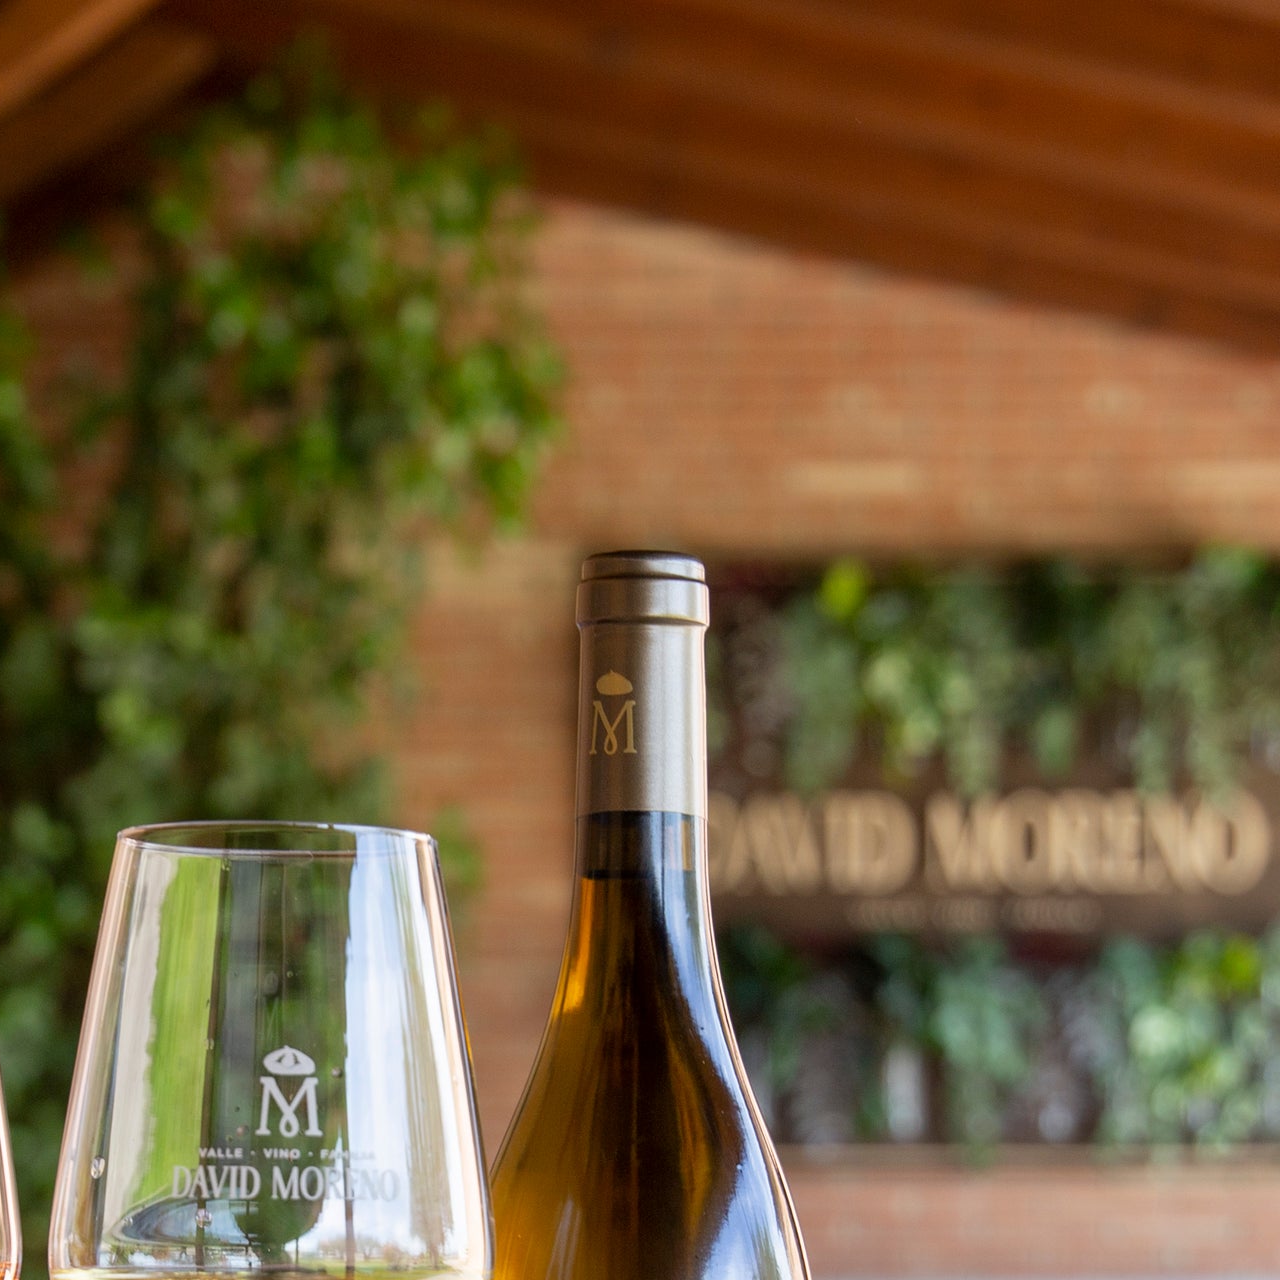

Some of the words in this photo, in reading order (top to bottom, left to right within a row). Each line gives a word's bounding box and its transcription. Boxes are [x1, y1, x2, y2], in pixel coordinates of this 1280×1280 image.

[589, 701, 637, 755] M
[707, 790, 918, 896] AVID
[926, 788, 1271, 896] MORENO
[255, 1076, 323, 1137] M
[199, 1148, 243, 1159] VALLE
[263, 1148, 301, 1159] VINO
[171, 1165, 260, 1200] DAVID
[271, 1165, 400, 1202] MORENO
